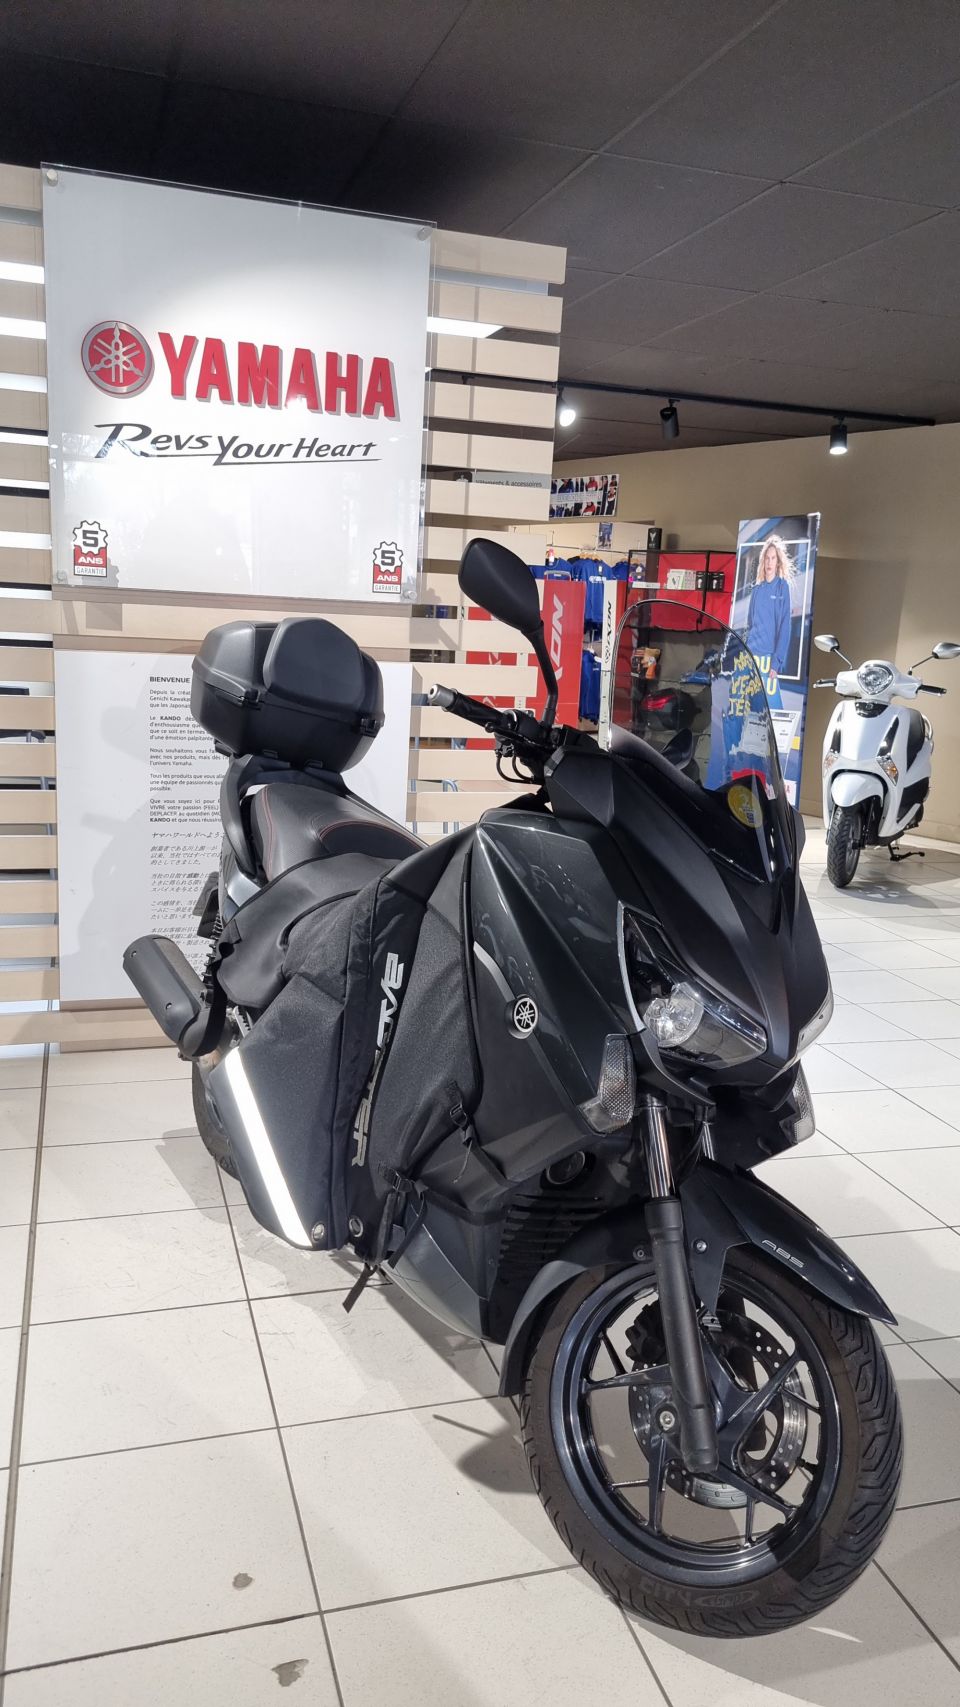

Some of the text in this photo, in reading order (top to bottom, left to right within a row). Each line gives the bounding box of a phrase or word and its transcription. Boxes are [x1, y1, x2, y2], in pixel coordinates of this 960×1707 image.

[158, 331, 400, 421] YAMAHA
[94, 423, 378, 466] Revs Your Heart
[511, 480, 542, 488] accessoires
[82, 529, 99, 547] 5
[78, 555, 104, 566] ANS
[380, 550, 396, 566] 5
[76, 567, 105, 576] GARANTIE
[377, 574, 399, 582] ANS
[374, 584, 399, 593] GARANTIE
[150, 676, 191, 684] BIENVENUE
[762, 1240, 804, 1268] ABS
